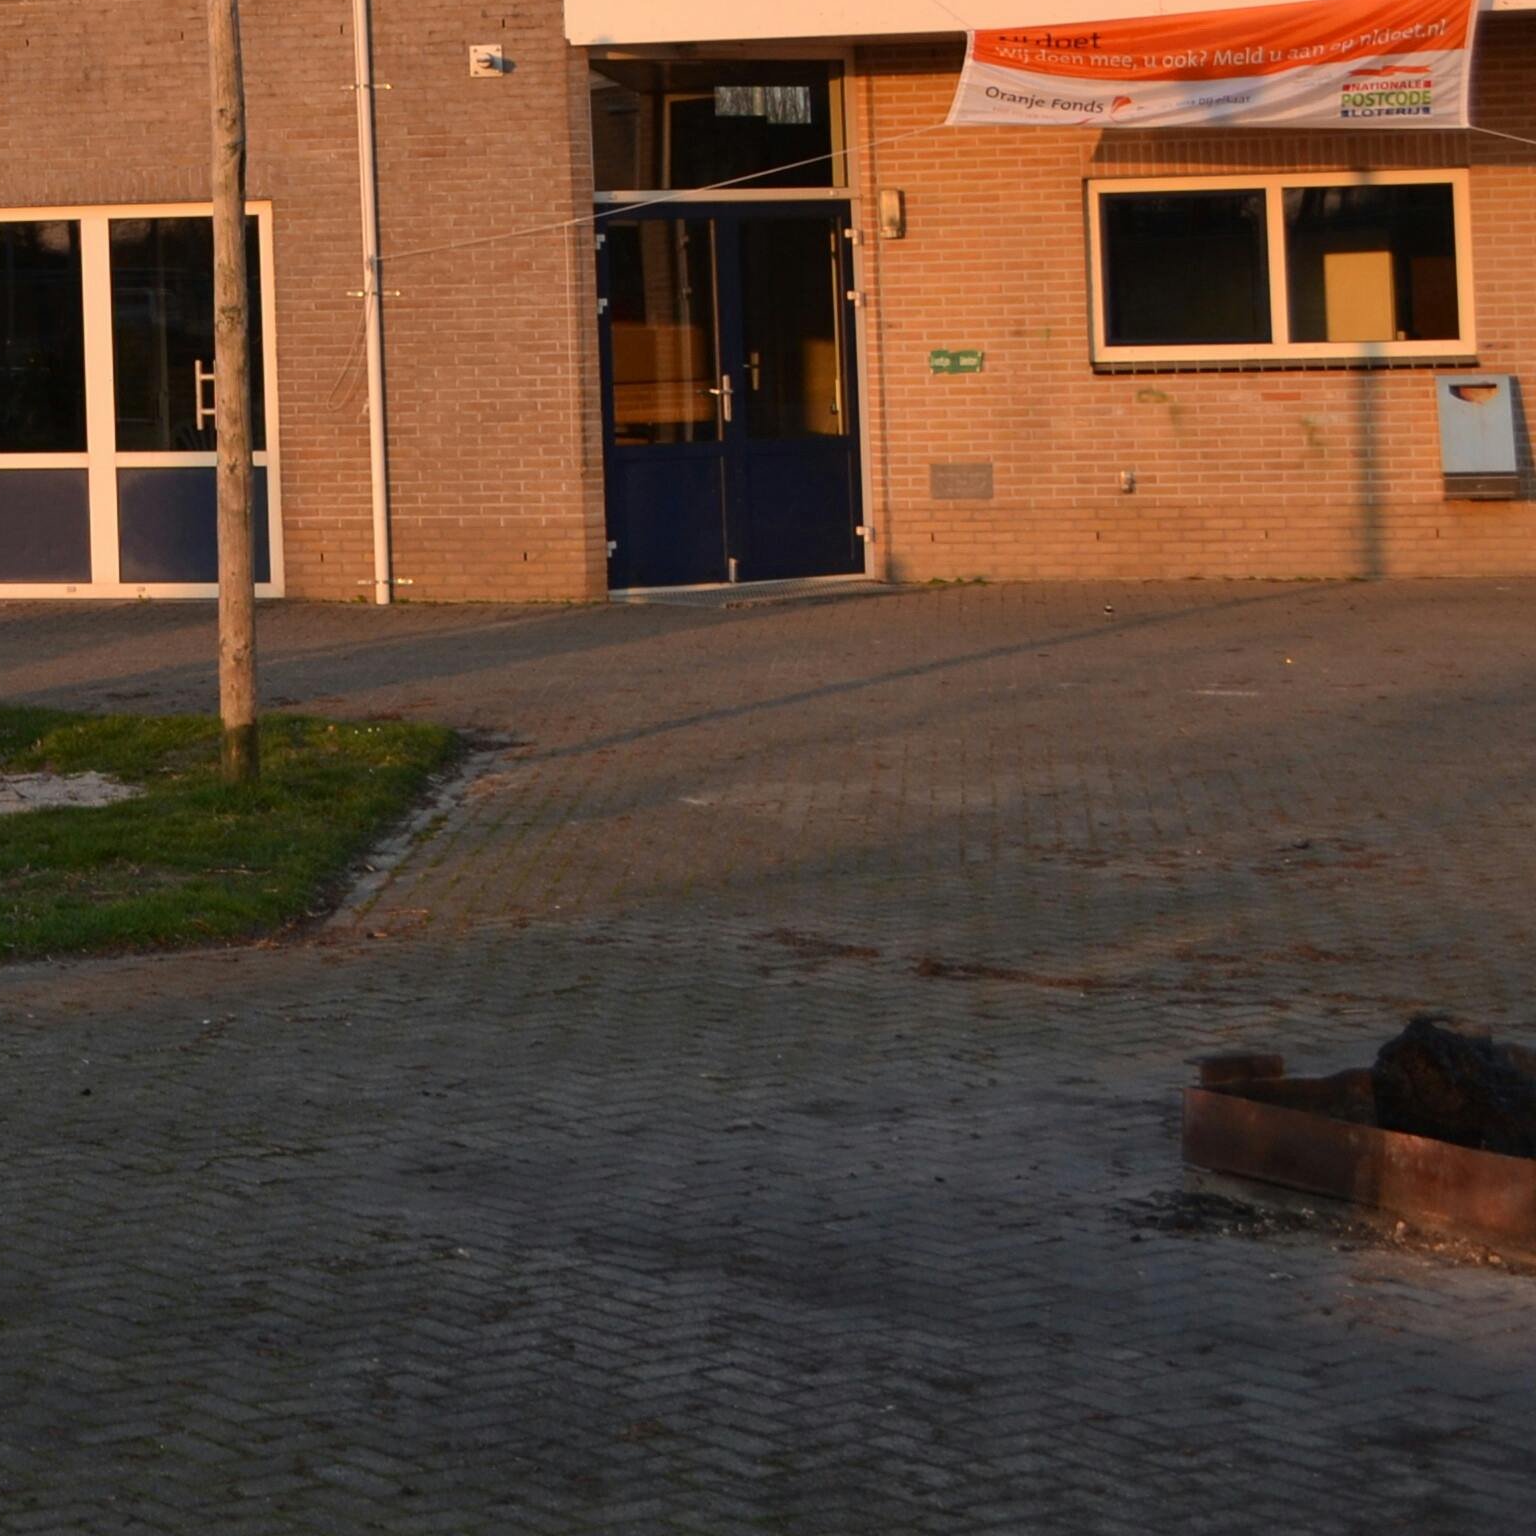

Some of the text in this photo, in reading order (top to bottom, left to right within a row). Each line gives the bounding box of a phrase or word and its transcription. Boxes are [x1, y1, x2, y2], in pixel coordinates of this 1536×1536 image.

[995, 46, 1029, 64] Wij
[1035, 49, 1084, 64] doen
[1090, 55, 1137, 71] mee,
[1144, 54, 1156, 68] u
[1162, 50, 1208, 69] ook?
[1213, 46, 1264, 66] Meld
[1270, 49, 1281, 62] u
[1288, 43, 1325, 61] aan
[1360, 18, 1448, 47] nldoet.nl
[1351, 80, 1424, 92] NATIONALE
[985, 86, 1046, 110] Oranje
[1051, 98, 1105, 114] Fonds
[1341, 90, 1432, 108] POSTCODE
[1351, 107, 1423, 118] LOTERIJ
